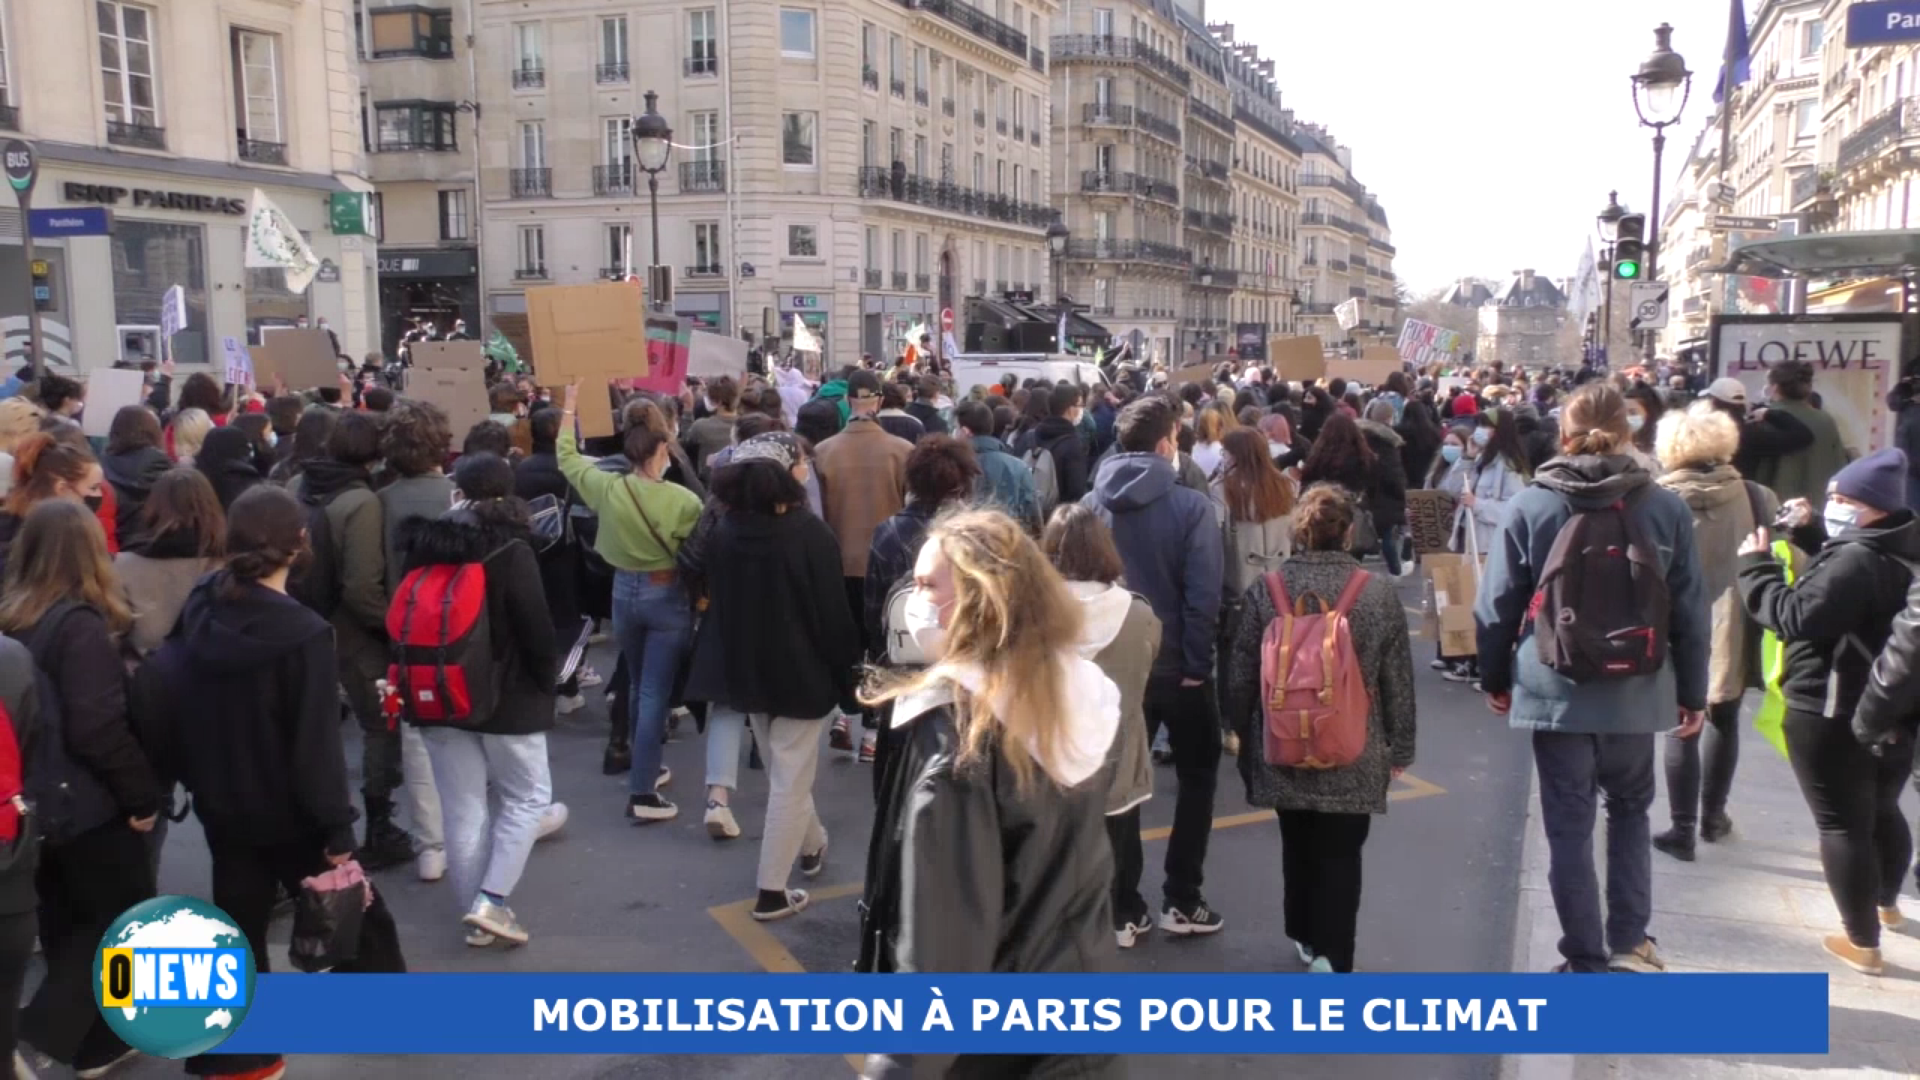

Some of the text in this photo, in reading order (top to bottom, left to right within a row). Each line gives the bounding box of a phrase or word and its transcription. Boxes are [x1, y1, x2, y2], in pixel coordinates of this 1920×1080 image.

[6, 152, 30, 168] BUS
[64, 181, 247, 216] BNP PARIBAS
[49, 217, 85, 228] Panthéon
[794, 295, 816, 307] CIC
[1640, 305, 1657, 316] 30
[1738, 340, 1882, 370] LOEWE
